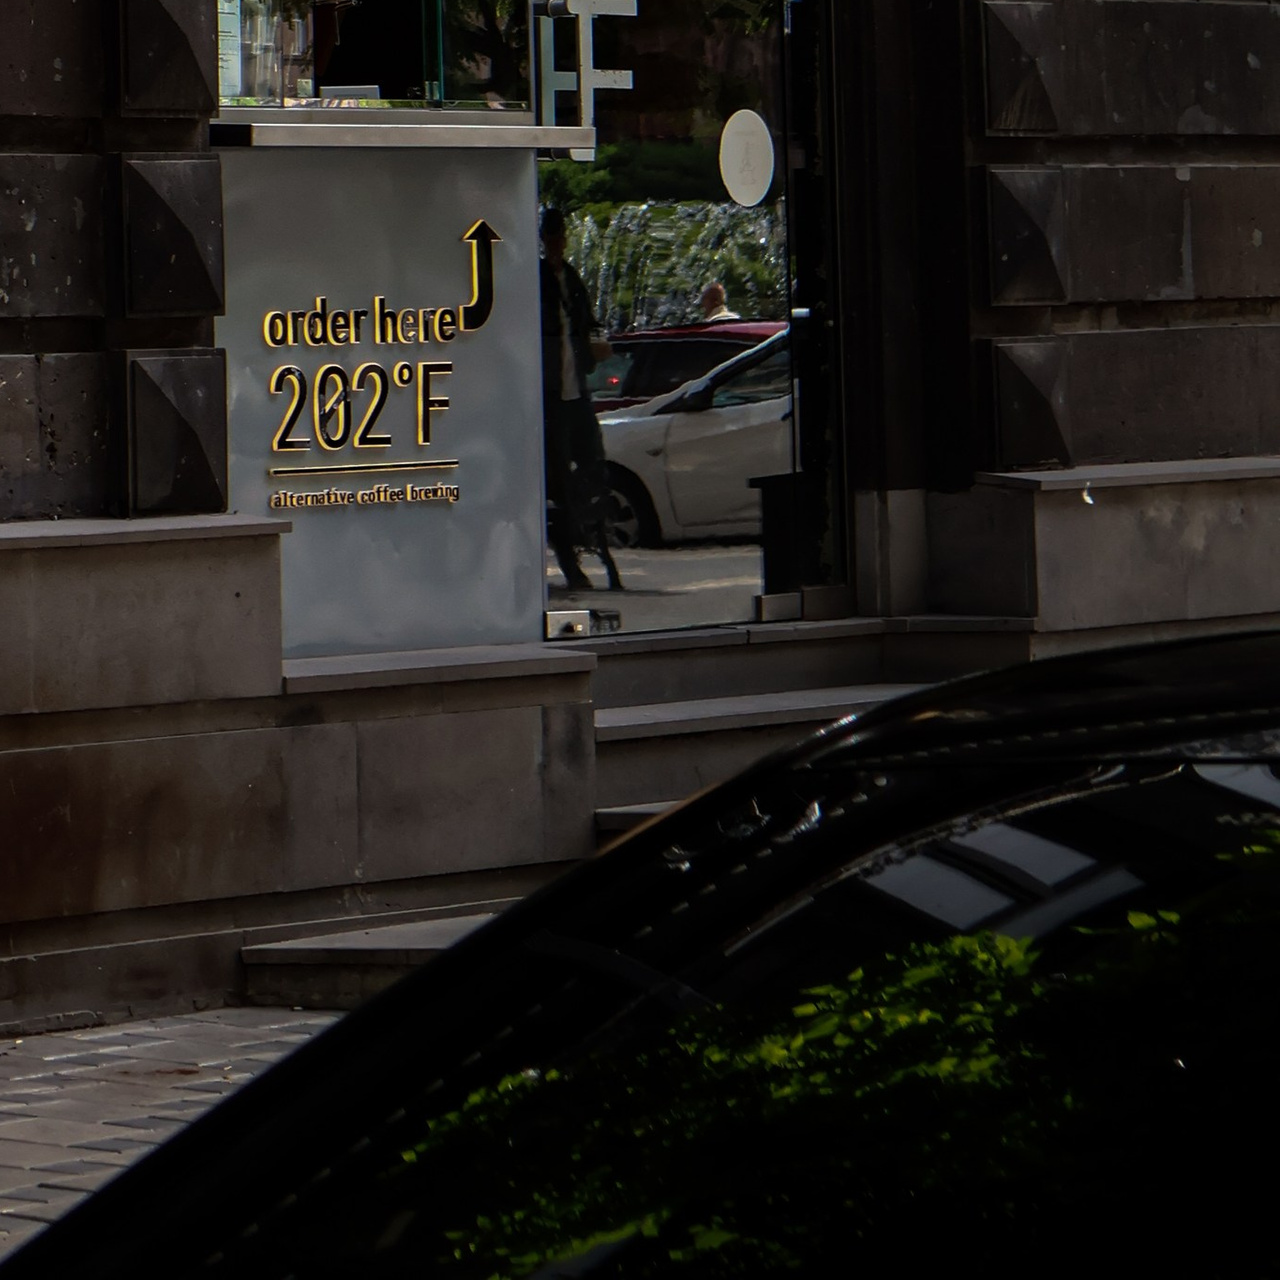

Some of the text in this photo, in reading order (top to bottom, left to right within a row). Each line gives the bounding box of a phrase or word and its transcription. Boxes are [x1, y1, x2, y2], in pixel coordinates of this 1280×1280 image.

[263, 295, 457, 347] order here
[270, 361, 453, 451] 202°F
[271, 481, 460, 509] alternative coffee brewing
